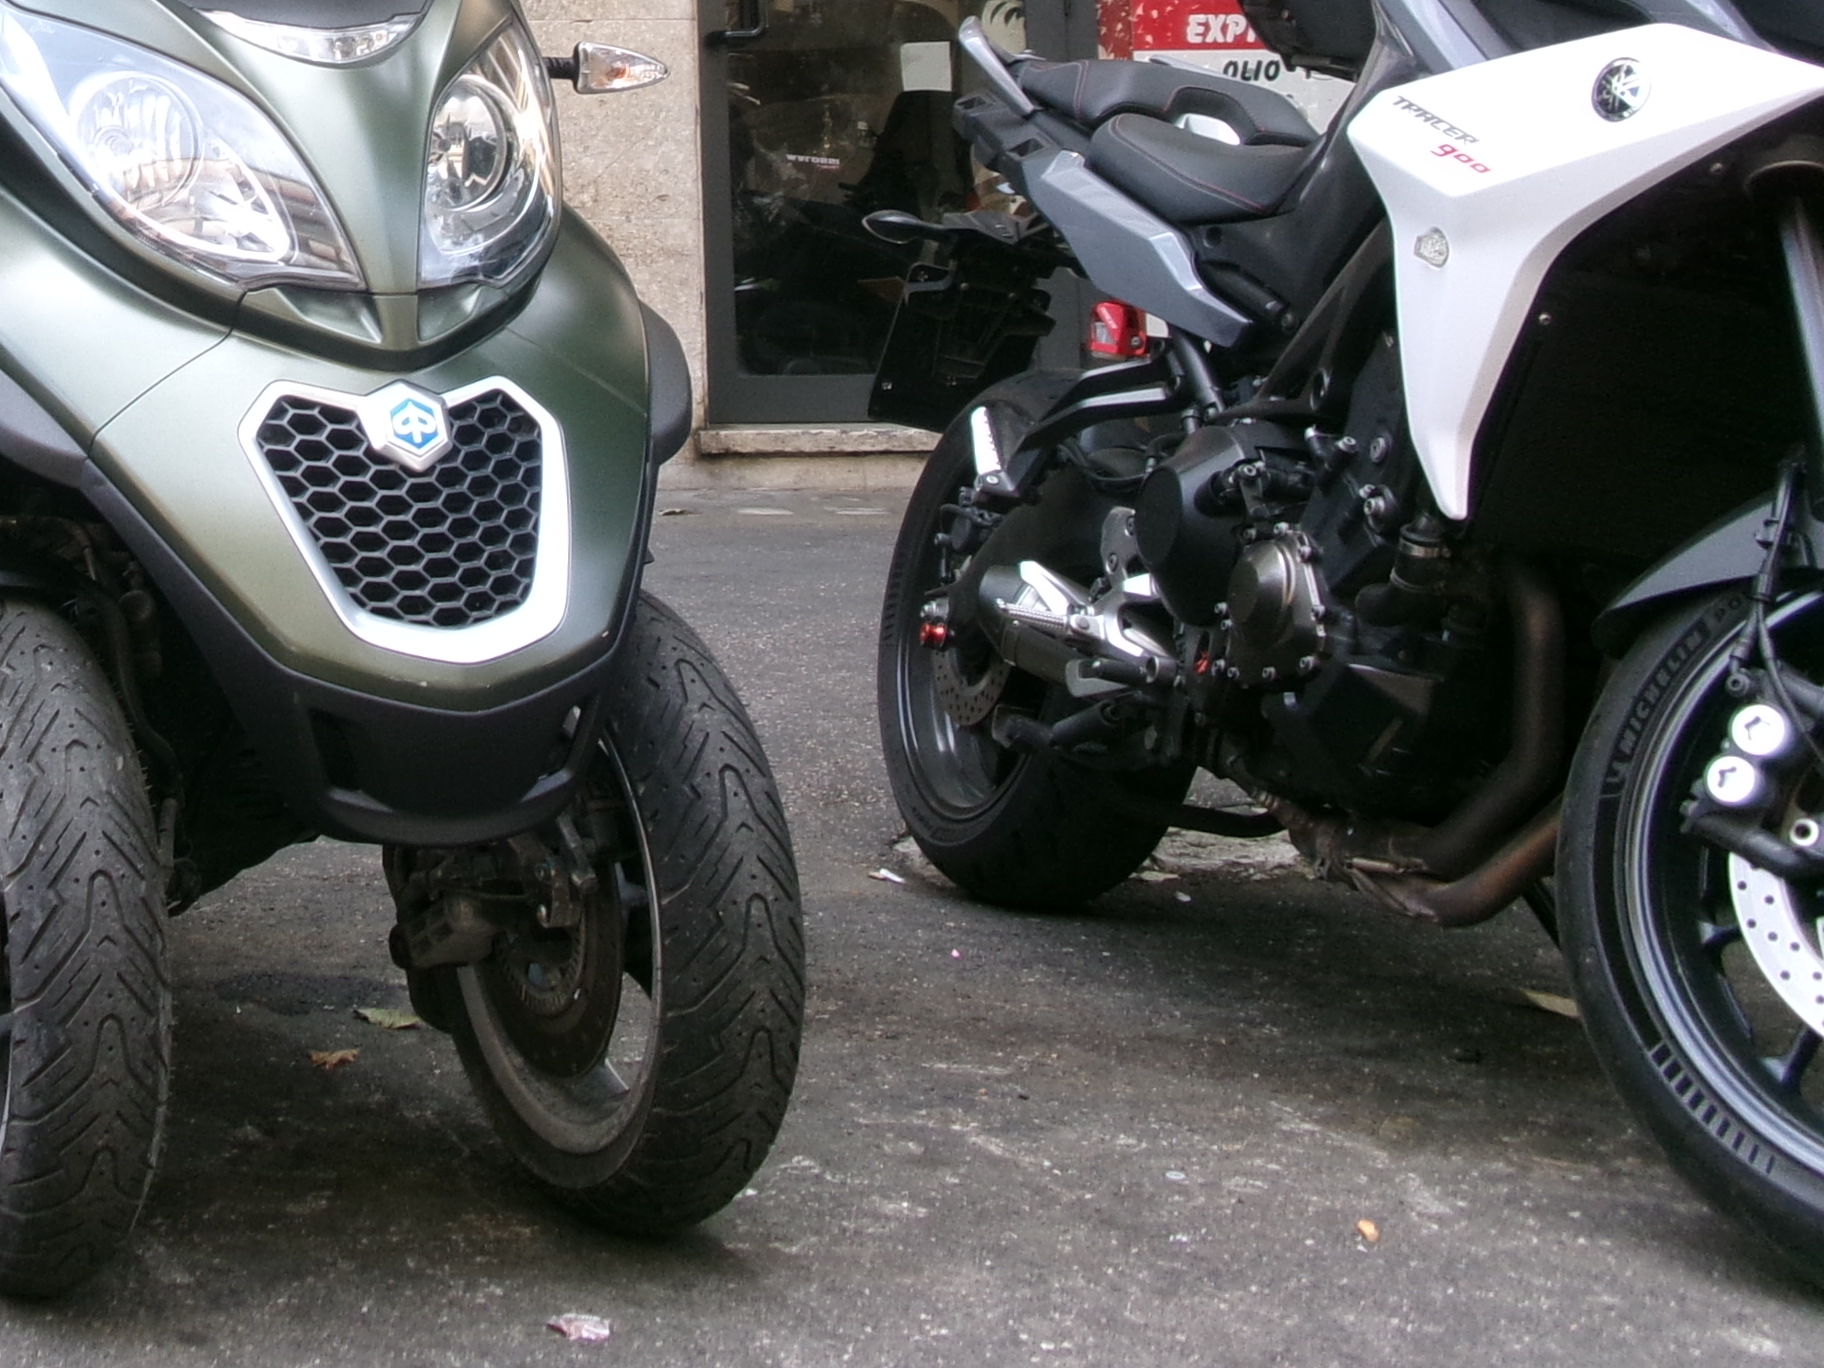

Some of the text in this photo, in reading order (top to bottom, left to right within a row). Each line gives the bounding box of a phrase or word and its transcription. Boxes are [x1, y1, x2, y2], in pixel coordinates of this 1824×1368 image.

[1223, 60, 1281, 82] OLIO
[1393, 95, 1480, 145] TRACER
[1430, 143, 1491, 173] 900
